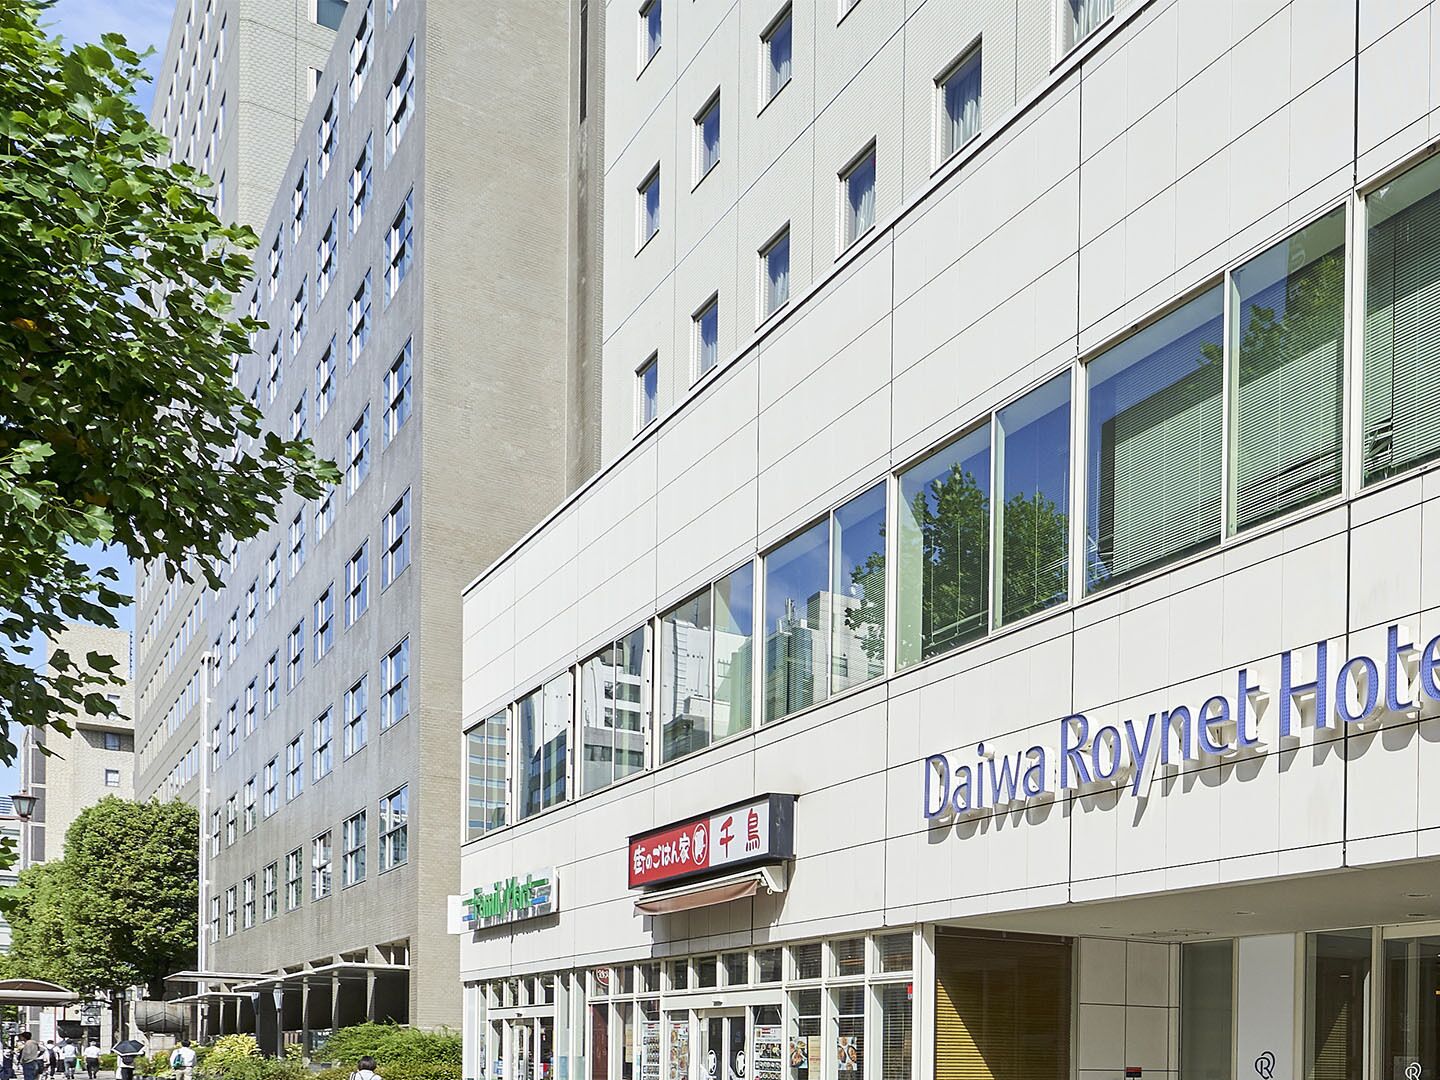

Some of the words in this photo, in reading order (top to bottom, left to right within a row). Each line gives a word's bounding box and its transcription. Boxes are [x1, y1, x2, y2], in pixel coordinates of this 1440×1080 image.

[923, 741, 1054, 820] Daiwa
[1060, 668, 1262, 798] Roynet
[633, 832, 691, 875] 街のごはん家
[467, 873, 541, 921] FamilyMart
